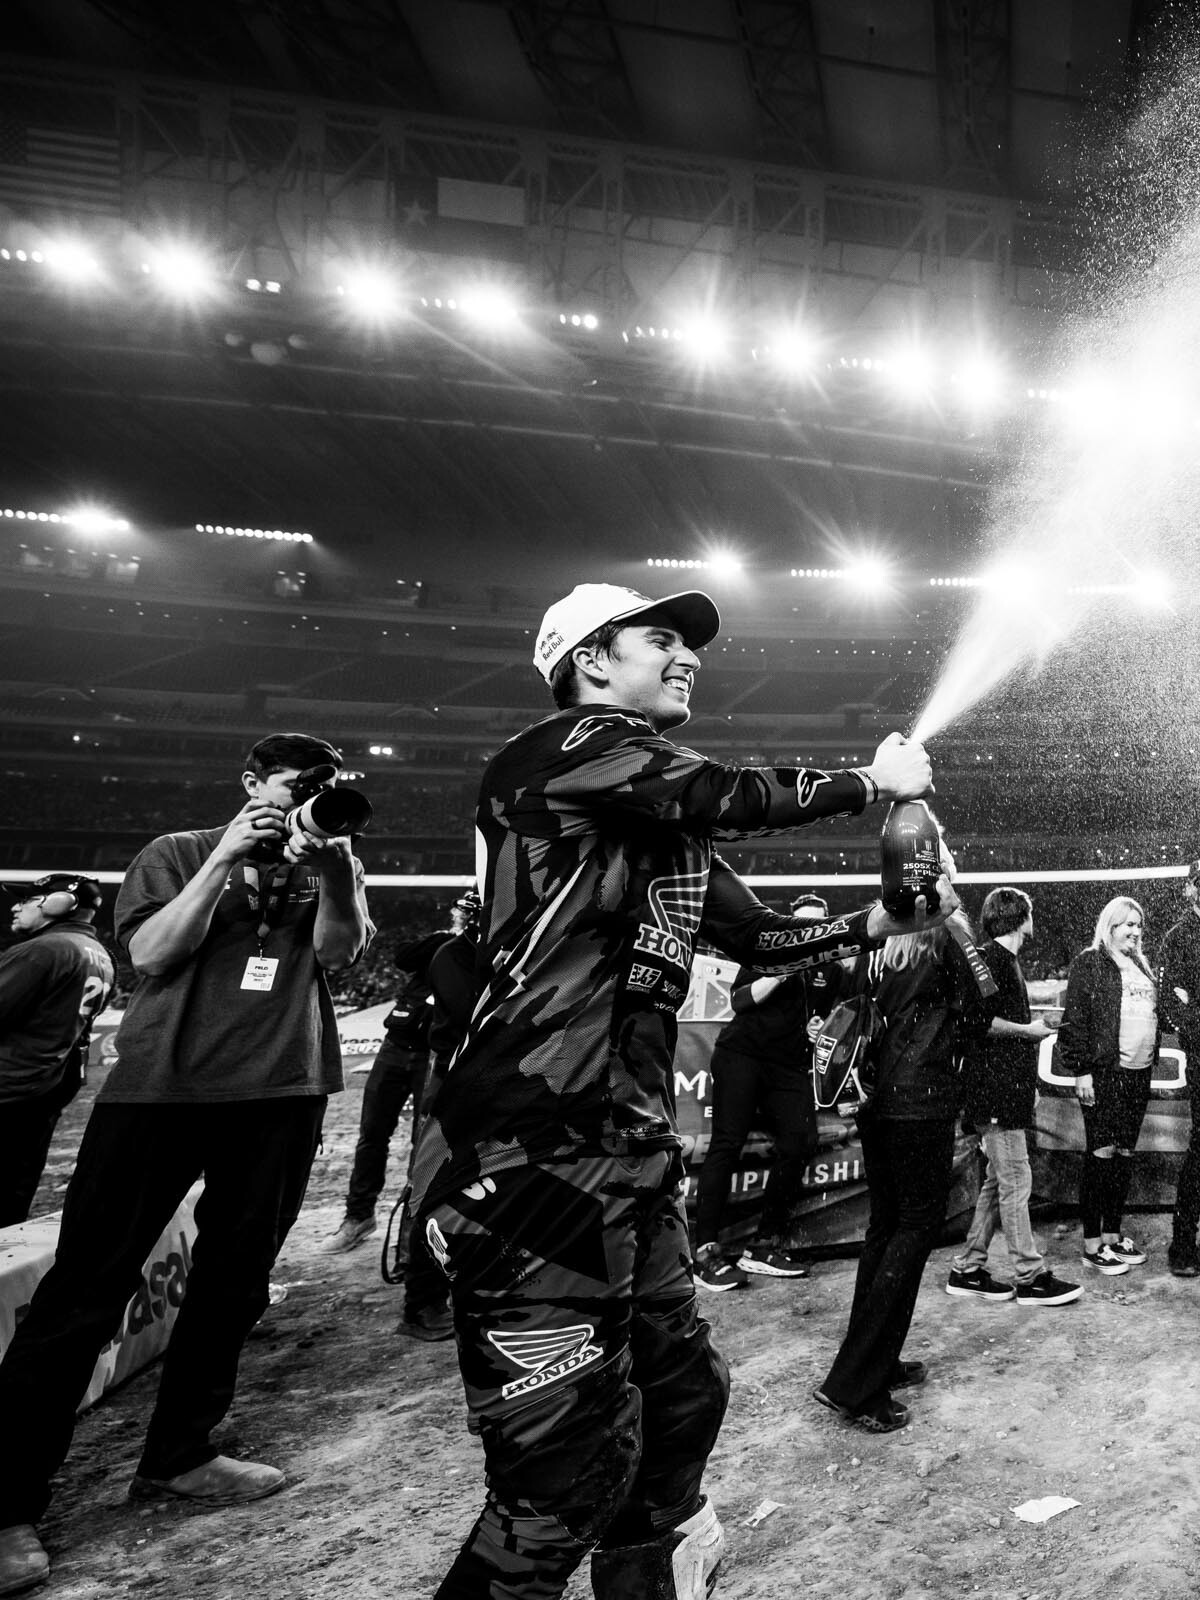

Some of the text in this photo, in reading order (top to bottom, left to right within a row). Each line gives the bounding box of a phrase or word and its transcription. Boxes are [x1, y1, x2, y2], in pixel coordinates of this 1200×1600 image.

[902, 862, 931, 870] 250SX
[633, 923, 694, 976] HON
[757, 919, 850, 951] HONDA
[505, 1345, 603, 1398] HONDA
